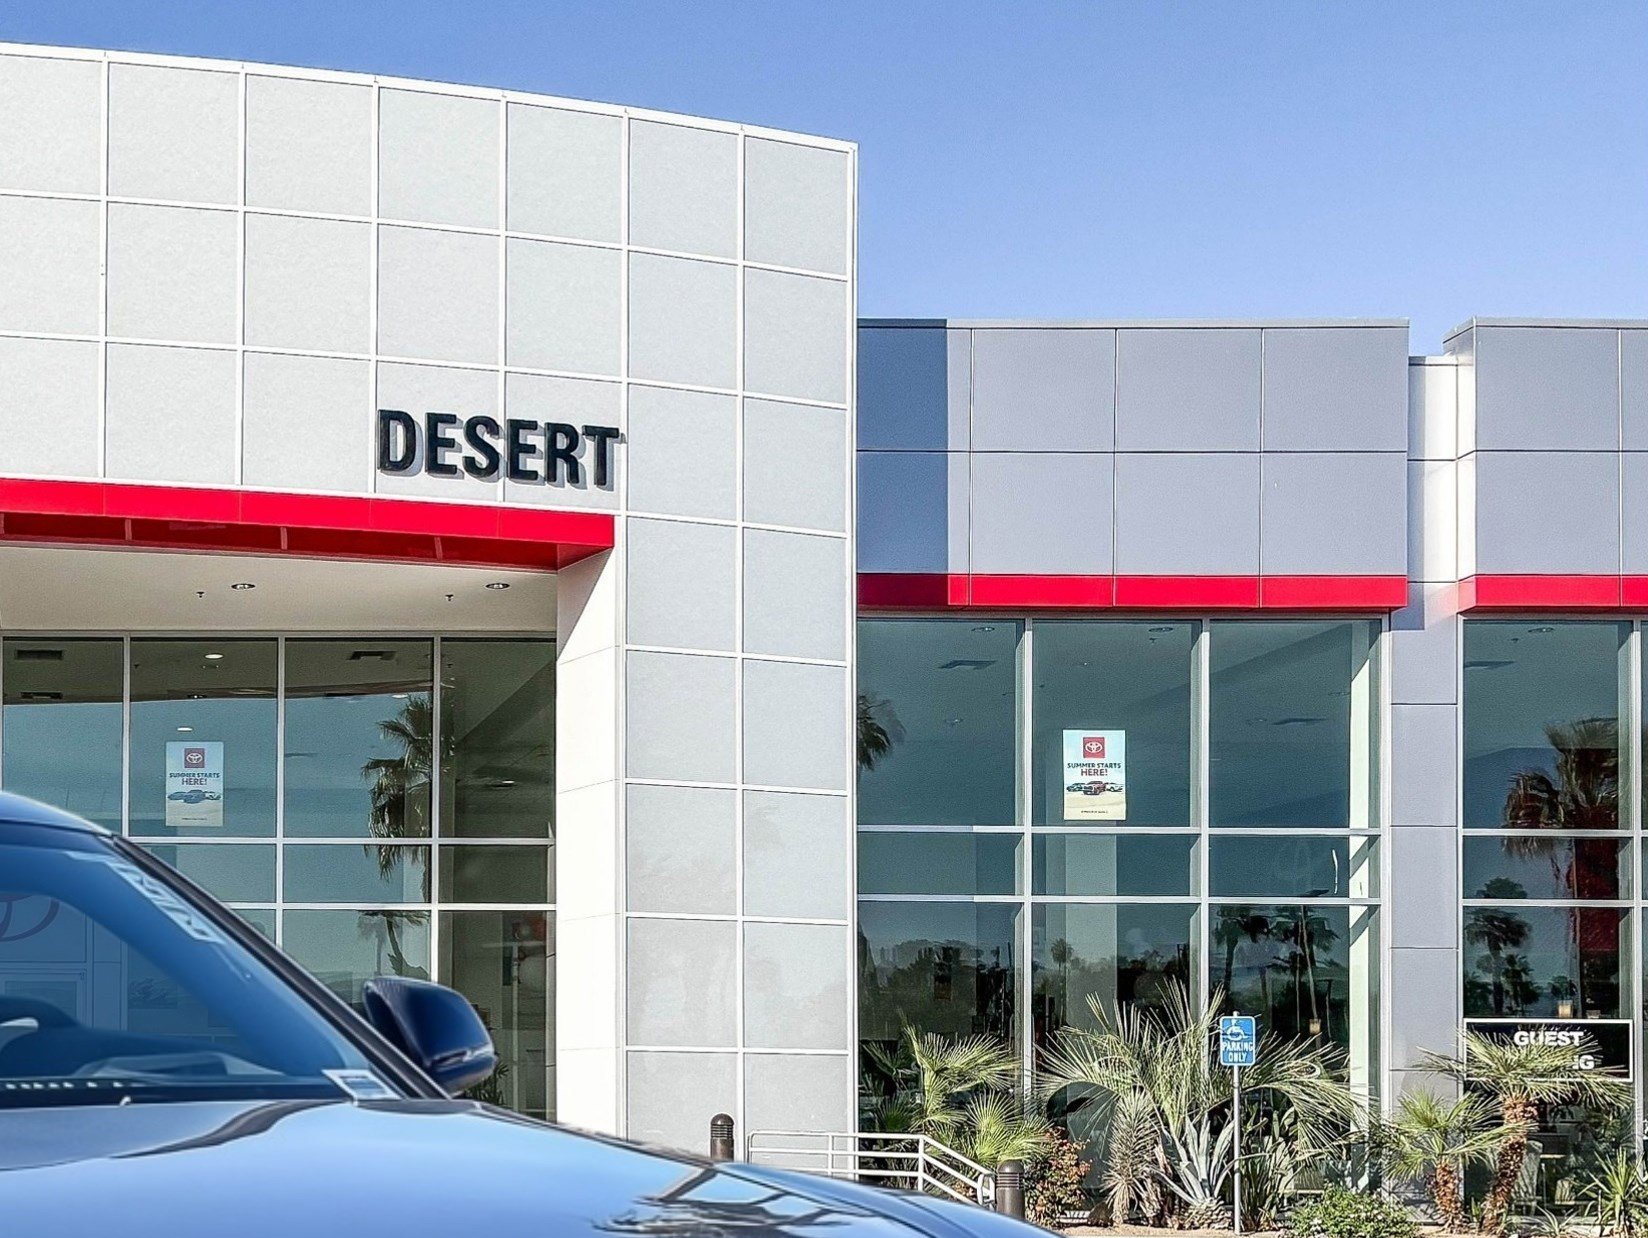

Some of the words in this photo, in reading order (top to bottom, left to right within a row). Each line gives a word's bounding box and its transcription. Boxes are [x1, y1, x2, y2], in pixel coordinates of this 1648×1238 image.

[377, 409, 620, 486] DESERT
[1080, 768, 1107, 776] HERE!
[181, 777, 207, 786] HERE!
[1513, 1030, 1585, 1047] GUEST
[1222, 1041, 1253, 1051] PARKING
[1228, 1051, 1247, 1062] ONLY
